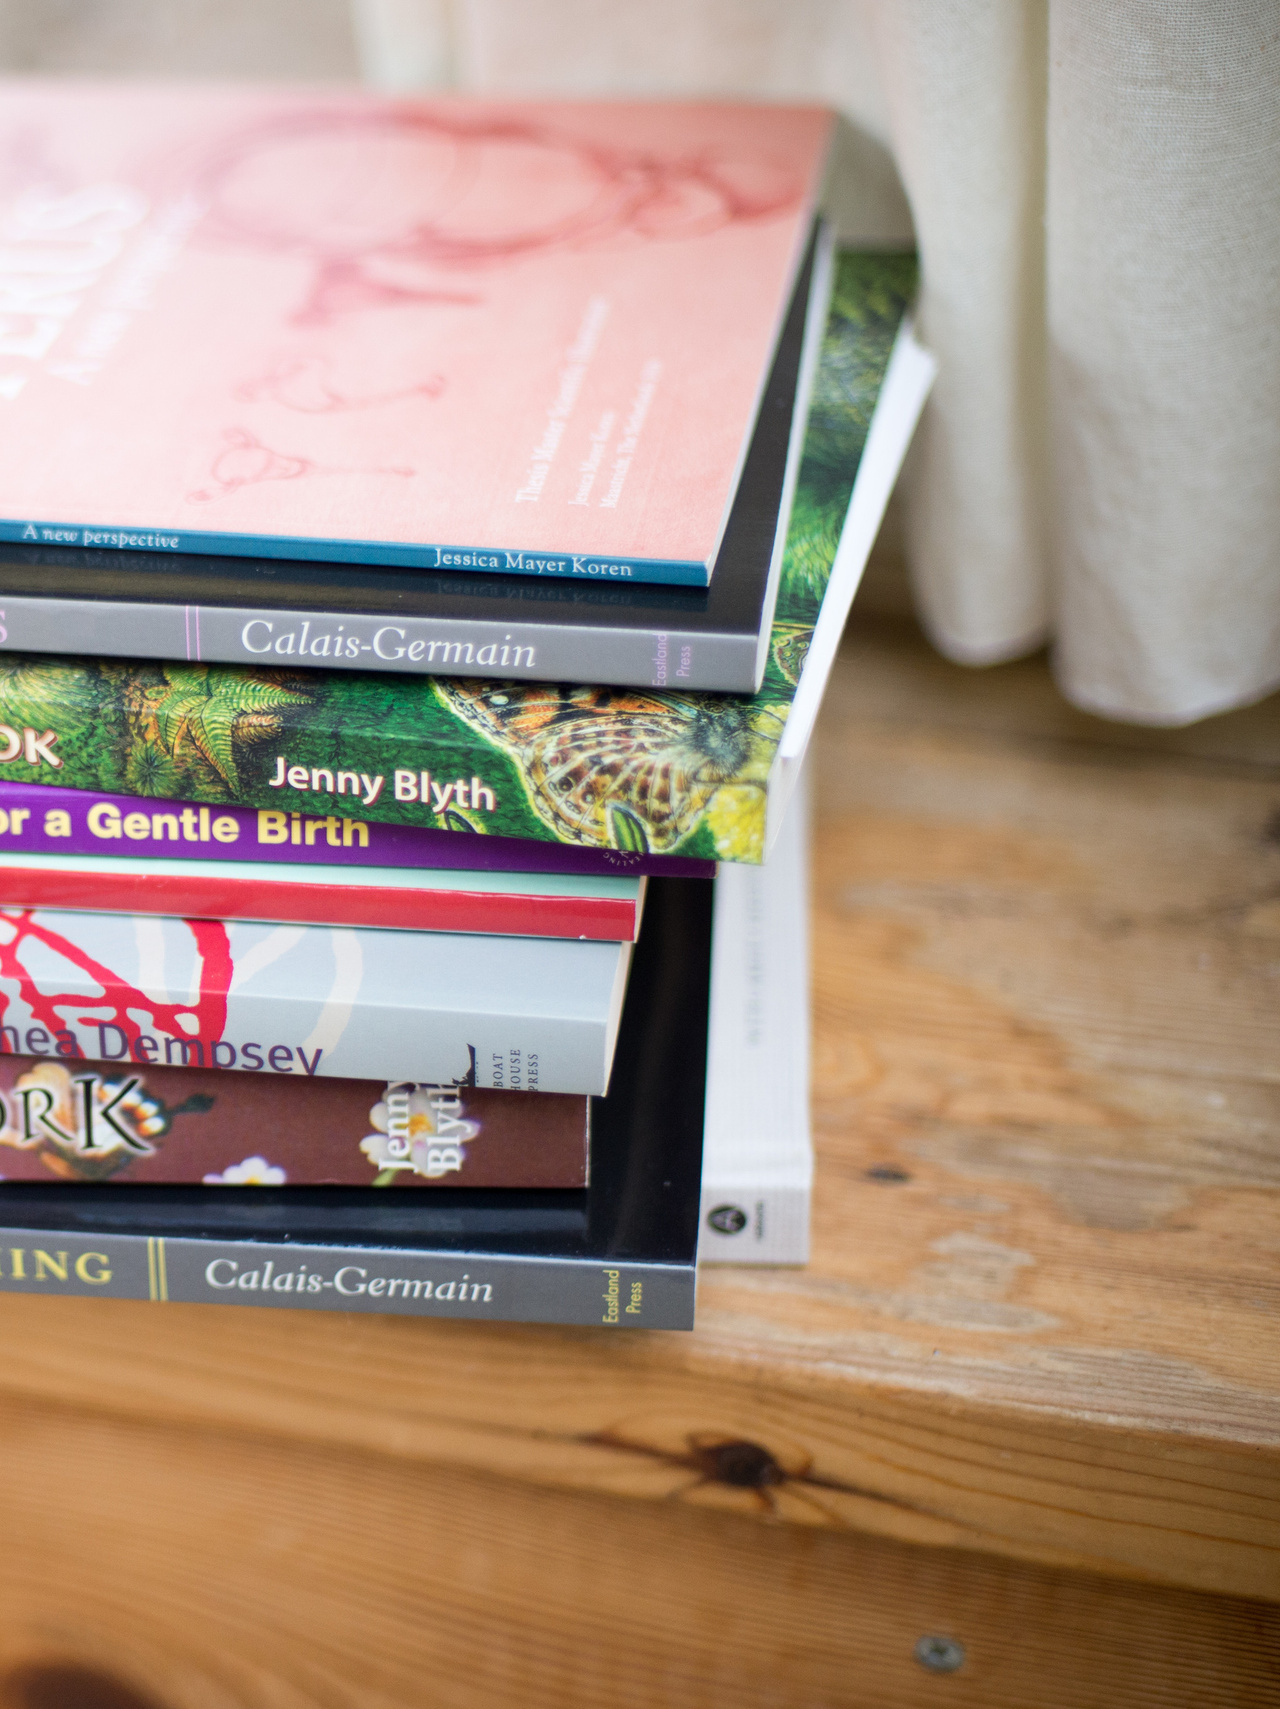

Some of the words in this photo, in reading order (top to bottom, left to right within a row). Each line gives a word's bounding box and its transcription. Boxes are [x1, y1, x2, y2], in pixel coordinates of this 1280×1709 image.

[23, 524, 39, 540] A
[43, 529, 77, 542] new
[83, 530, 179, 549] perspective
[434, 548, 499, 569] Jessica
[505, 552, 566, 575] Mayer
[572, 557, 633, 577] Koren
[241, 619, 536, 668] Calais-Germain
[652, 632, 667, 686] Eastland
[676, 646, 691, 677] Press
[269, 757, 384, 806] Jenny
[393, 768, 497, 813] Blyth
[44, 811, 73, 838] a
[86, 802, 240, 844] Gentle
[258, 810, 369, 847] Birth
[97, 1022, 324, 1076] Dempsey
[492, 1053, 503, 1087] BOAT
[510, 1049, 521, 1091] HOUSE
[527, 1053, 539, 1092] PRESS
[205, 1258, 494, 1303] Calais-Germain
[602, 1269, 620, 1323] Eastland
[625, 1282, 642, 1313] Press
